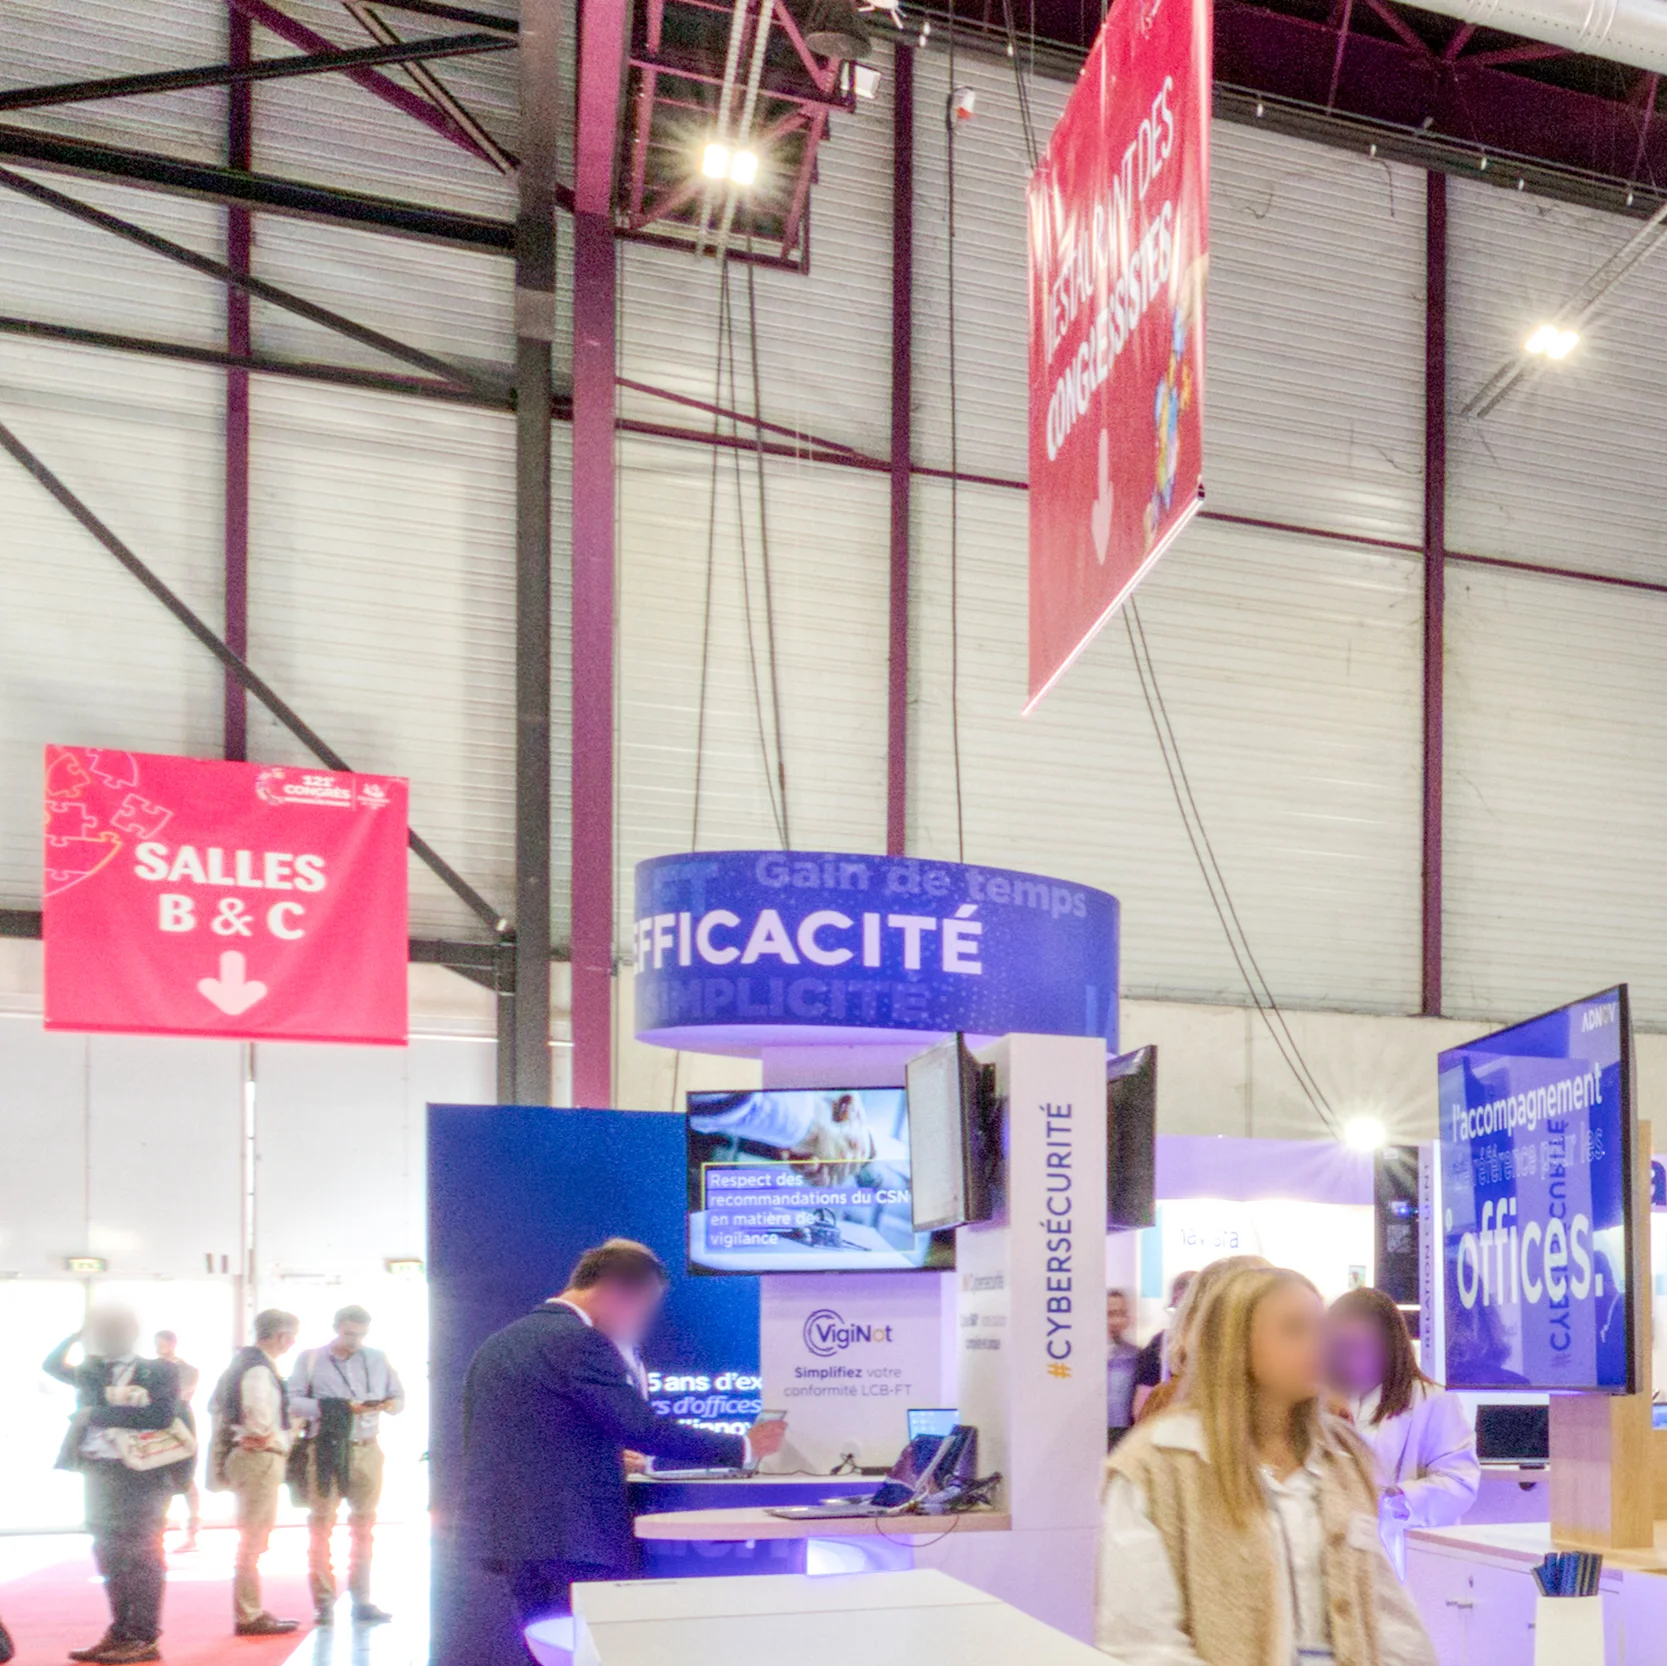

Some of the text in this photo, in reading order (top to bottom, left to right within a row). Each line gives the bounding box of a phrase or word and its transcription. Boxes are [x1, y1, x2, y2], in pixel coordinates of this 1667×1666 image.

[1137, 75, 1174, 200] DES
[134, 841, 328, 893] SALLES
[755, 852, 870, 890] Gain
[886, 859, 950, 897] de
[964, 867, 1088, 918] temps
[158, 893, 306, 941] B & C
[1581, 1002, 1617, 1033] ADNOV
[1452, 1062, 1603, 1143] l'accompagnement
[710, 1172, 803, 1189] Respect des
[710, 1187, 909, 1207] recommandations du CSN
[711, 1211, 815, 1226] en matière de
[710, 1231, 778, 1248] vigilance
[1039, 1102, 1073, 1379] #CYBERSÉCURITÉ
[1457, 1196, 1604, 1310] offices.
[816, 1323, 893, 1349] VigiNot
[664, 1375, 711, 1392] ans
[794, 1366, 903, 1380] Simplifiez votre
[783, 1383, 913, 1398] conformité LCB-FT
[673, 1394, 763, 1418] d'offices
